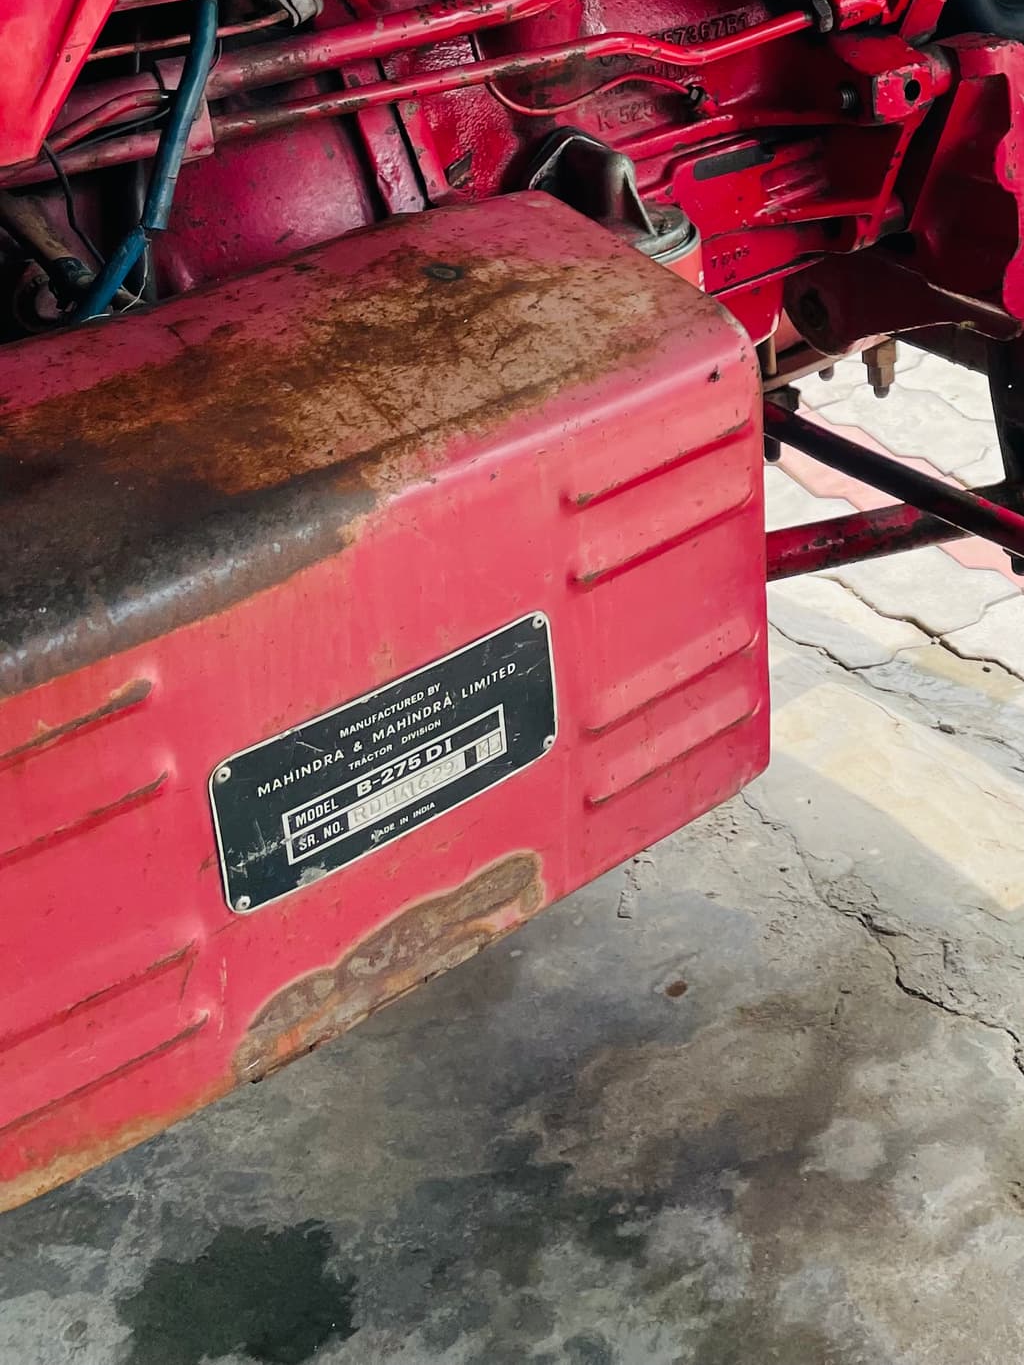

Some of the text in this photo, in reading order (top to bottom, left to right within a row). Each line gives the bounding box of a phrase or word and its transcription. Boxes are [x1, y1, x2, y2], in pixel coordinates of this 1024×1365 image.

[257, 662, 516, 797] MAHINDRA & MAHINDRA LIMITED
[340, 683, 441, 739] MANUFACTURED BY
[348, 720, 441, 771] TRACTOR DIVISION
[295, 738, 453, 828] MODEL B-275 DI
[299, 831, 320, 851] SR.
[323, 820, 344, 840] NO.
[400, 815, 409, 826] IN
[413, 802, 435, 818] INDIA
